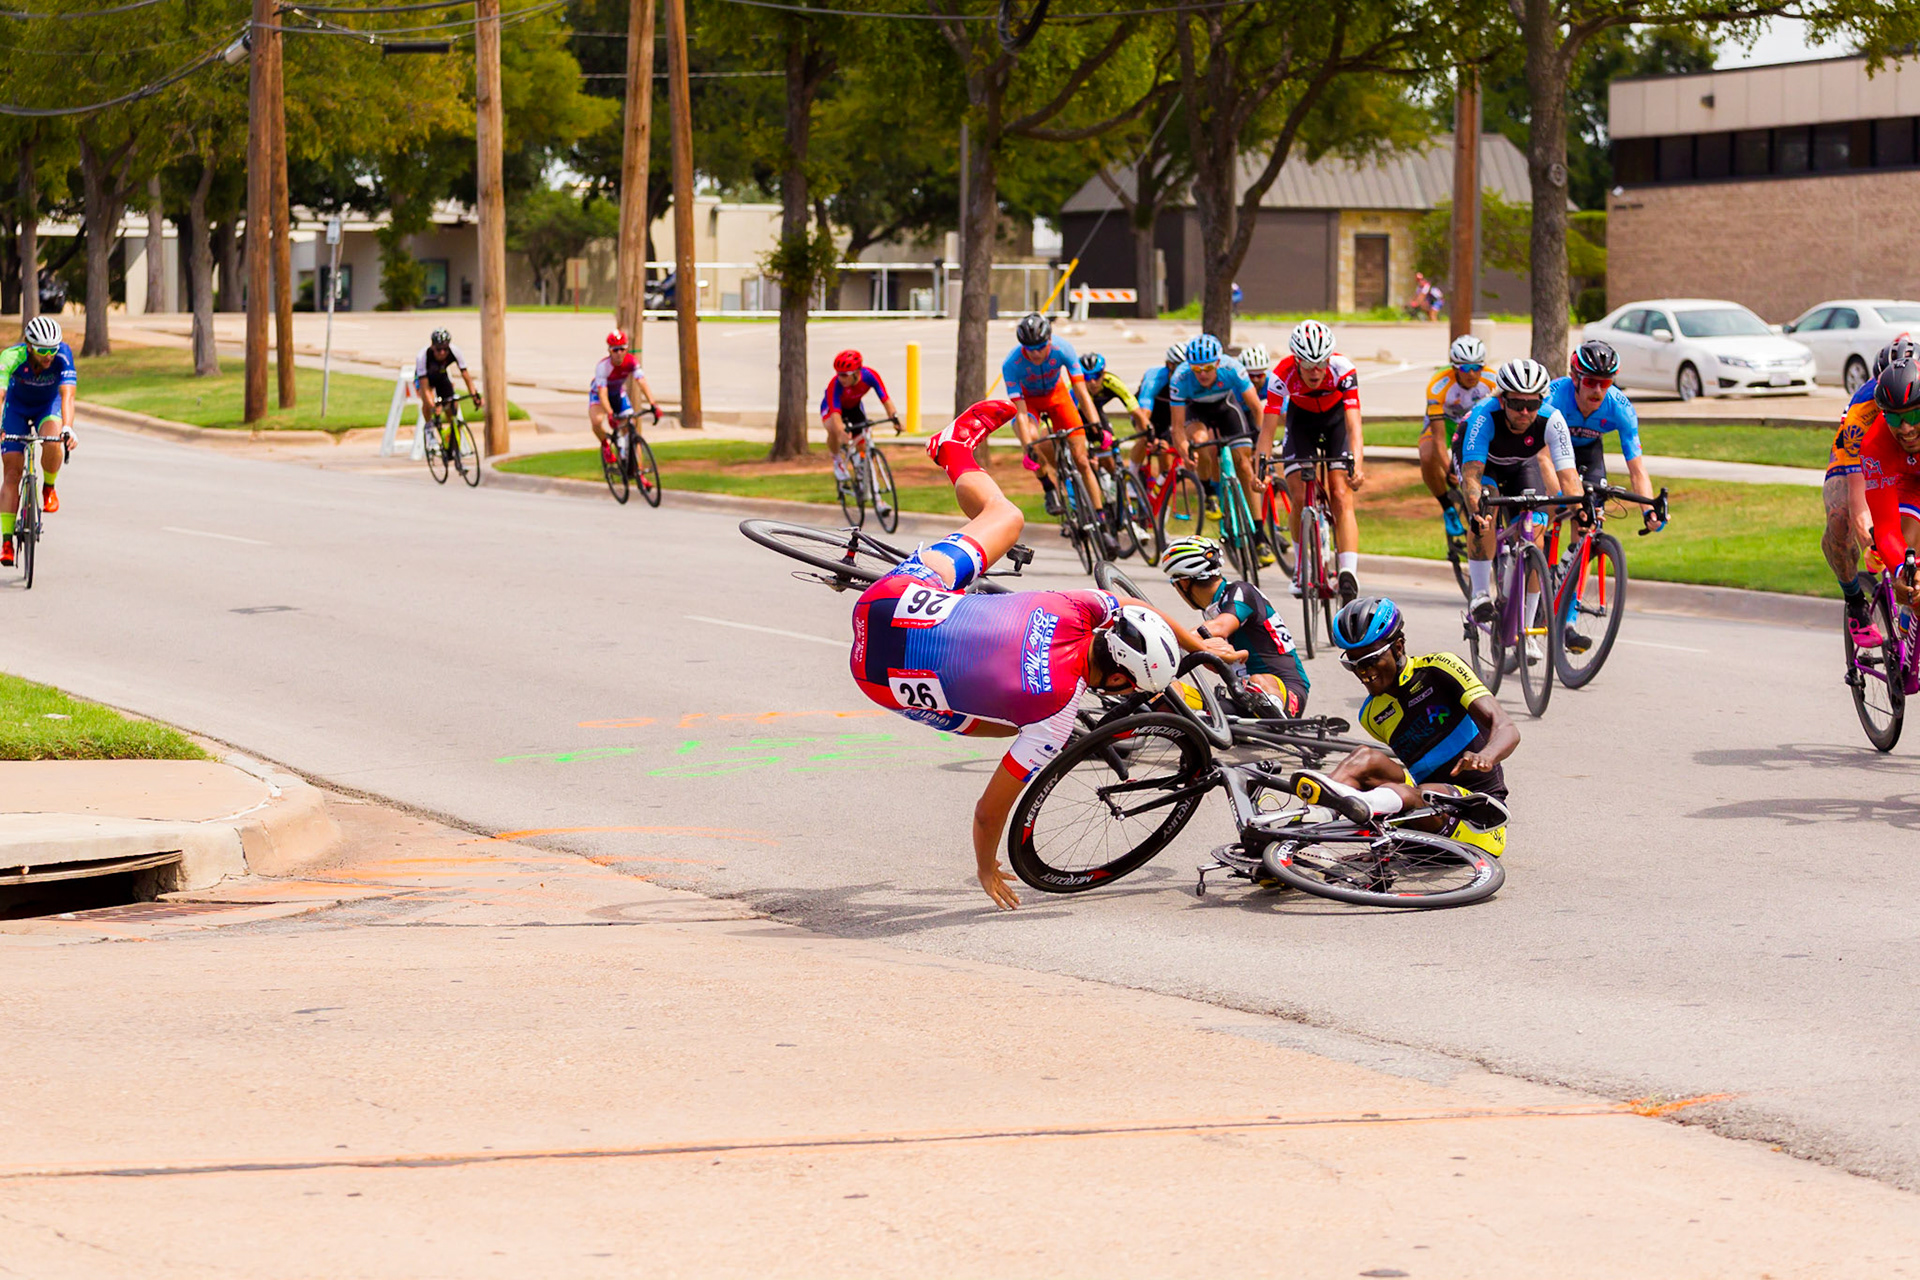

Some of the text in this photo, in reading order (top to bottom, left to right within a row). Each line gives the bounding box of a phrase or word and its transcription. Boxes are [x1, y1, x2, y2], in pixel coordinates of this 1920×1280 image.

[1466, 414, 1487, 451] BROOKS
[1553, 421, 1570, 456] BROOKS
[907, 589, 950, 616] 26
[1028, 607, 1049, 650] Bike
[1041, 613, 1059, 692] RICHARDSON
[900, 682, 938, 710] 26
[1130, 725, 1186, 739] MERCURY
[1023, 772, 1060, 829] MERCURY
[1162, 796, 1194, 840] RCURY
[1039, 872, 1095, 887] MERCURY
